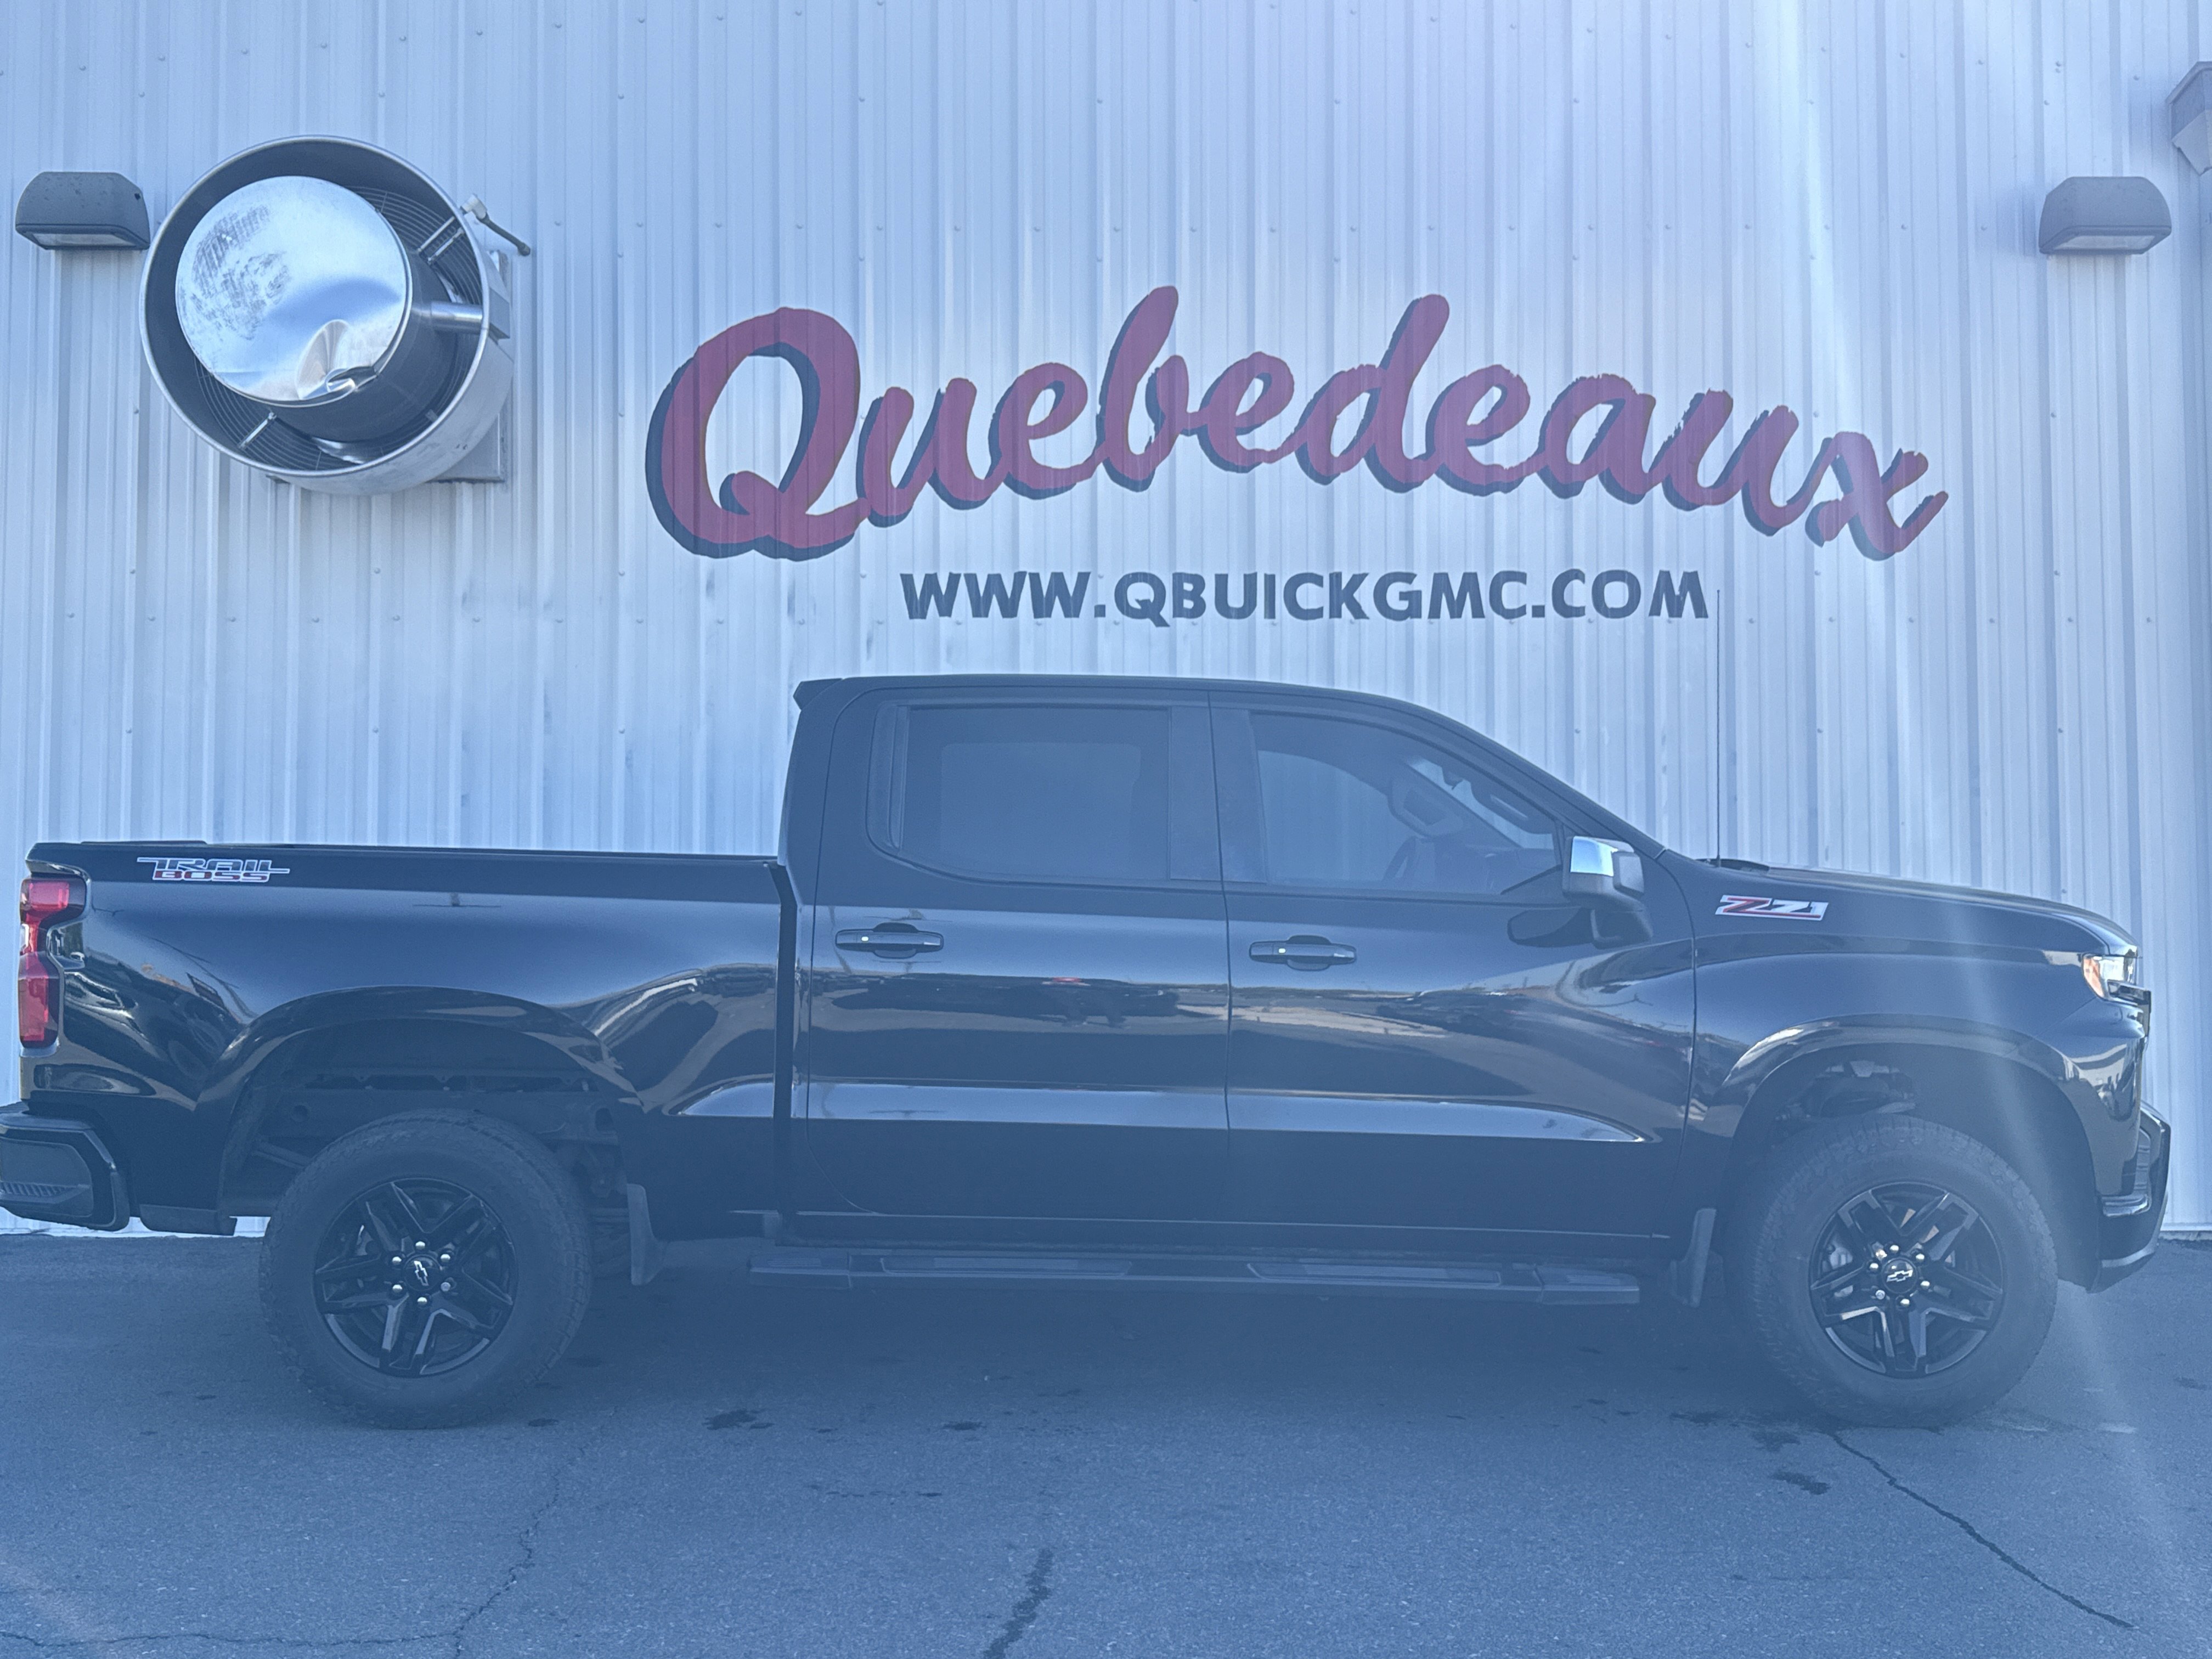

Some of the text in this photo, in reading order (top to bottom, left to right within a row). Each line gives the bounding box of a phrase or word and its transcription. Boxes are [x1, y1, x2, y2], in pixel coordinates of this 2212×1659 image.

[645, 286, 1948, 560] Quebedeaux
[900, 569, 1708, 627] WWW.QBUICKGMC.COM
[137, 857, 290, 873] TRAIL
[153, 870, 270, 882] BOSS
[1715, 895, 1829, 921] Z71
